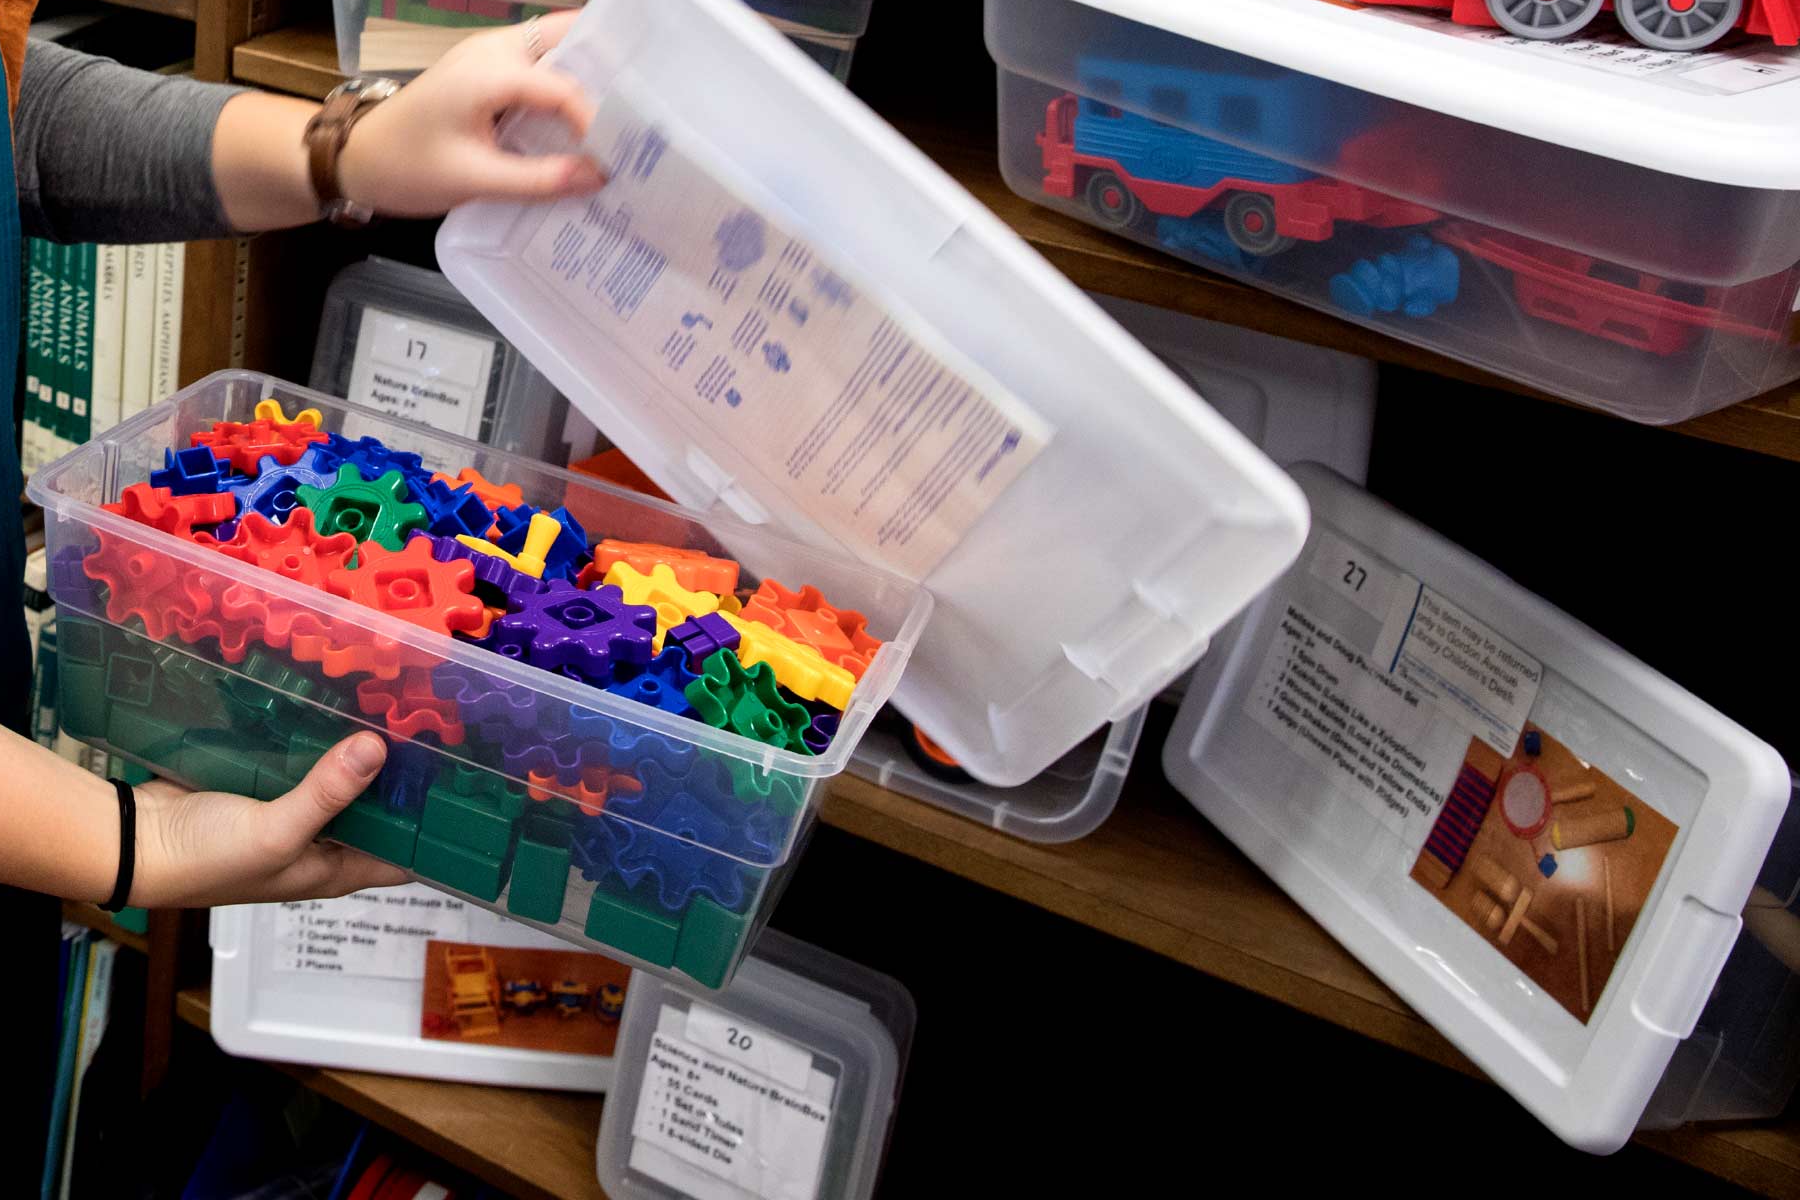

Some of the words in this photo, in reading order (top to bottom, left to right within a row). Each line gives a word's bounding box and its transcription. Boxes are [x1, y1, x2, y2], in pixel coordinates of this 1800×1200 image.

[28, 265, 42, 348] ANIMALS
[40, 273, 55, 358] ANIMALS
[58, 279, 73, 365] ANIMALS
[73, 285, 90, 370] ANIMALS
[158, 308, 171, 396] AMPHIBIANS
[407, 339, 427, 360] 17
[371, 389, 399, 405] Ages:
[374, 374, 408, 391] Nature
[1343, 561, 1367, 591] 27
[1281, 621, 1303, 643] Ages:
[1442, 612, 1460, 628] item
[1463, 627, 1480, 643] may
[1483, 639, 1497, 652] be
[1498, 651, 1537, 680] returned
[1287, 606, 1315, 633] Melissa
[1317, 630, 1331, 644] and
[1332, 641, 1353, 663] Doug
[1404, 692, 1418, 706] Set
[1412, 626, 1440, 652] Library
[1443, 647, 1486, 683] Children's
[1417, 613, 1433, 629] only
[1435, 624, 1446, 637] to
[1447, 633, 1480, 659] Gordon
[1483, 656, 1517, 686] Avenue
[1298, 650, 1314, 669] Spin
[1317, 665, 1337, 684] Drum
[1287, 679, 1317, 706] Wooden
[1319, 704, 1346, 728] Mallets
[1347, 726, 1371, 748] (Look
[1373, 745, 1390, 761] Like
[1391, 759, 1444, 805] Drumsticks)
[1322, 688, 1350, 712] (Looks
[1351, 710, 1368, 727] Like
[1378, 729, 1426, 771] Xylophone)
[1298, 725, 1331, 755] (Uneven
[1333, 751, 1356, 775] Pipes
[1357, 772, 1374, 789] with
[1302, 709, 1329, 734] Shaker
[1330, 730, 1358, 756] (Green
[1360, 754, 1375, 769] and
[1376, 767, 1404, 792] Yellow
[1405, 790, 1430, 814] Ends)
[386, 897, 406, 906] and
[409, 898, 441, 909] Boats
[446, 900, 464, 910] Set
[308, 932, 348, 944] Orange
[351, 935, 377, 946] Bear
[384, 924, 437, 937] Bulldozer
[306, 961, 343, 971] Planes
[307, 946, 339, 957] Boats
[727, 1027, 752, 1050] 20
[651, 1054, 680, 1073] Ages:
[654, 1038, 698, 1065] Science
[703, 1061, 725, 1076] and
[728, 1071, 767, 1095] Nature
[770, 1089, 826, 1122] BrainBox
[668, 1077, 680, 1090] 55
[683, 1086, 718, 1107] Cards
[675, 1097, 694, 1113] Set
[671, 1113, 700, 1132] Sand
[704, 1126, 736, 1149] Timer
[713, 1149, 732, 1164] Die
